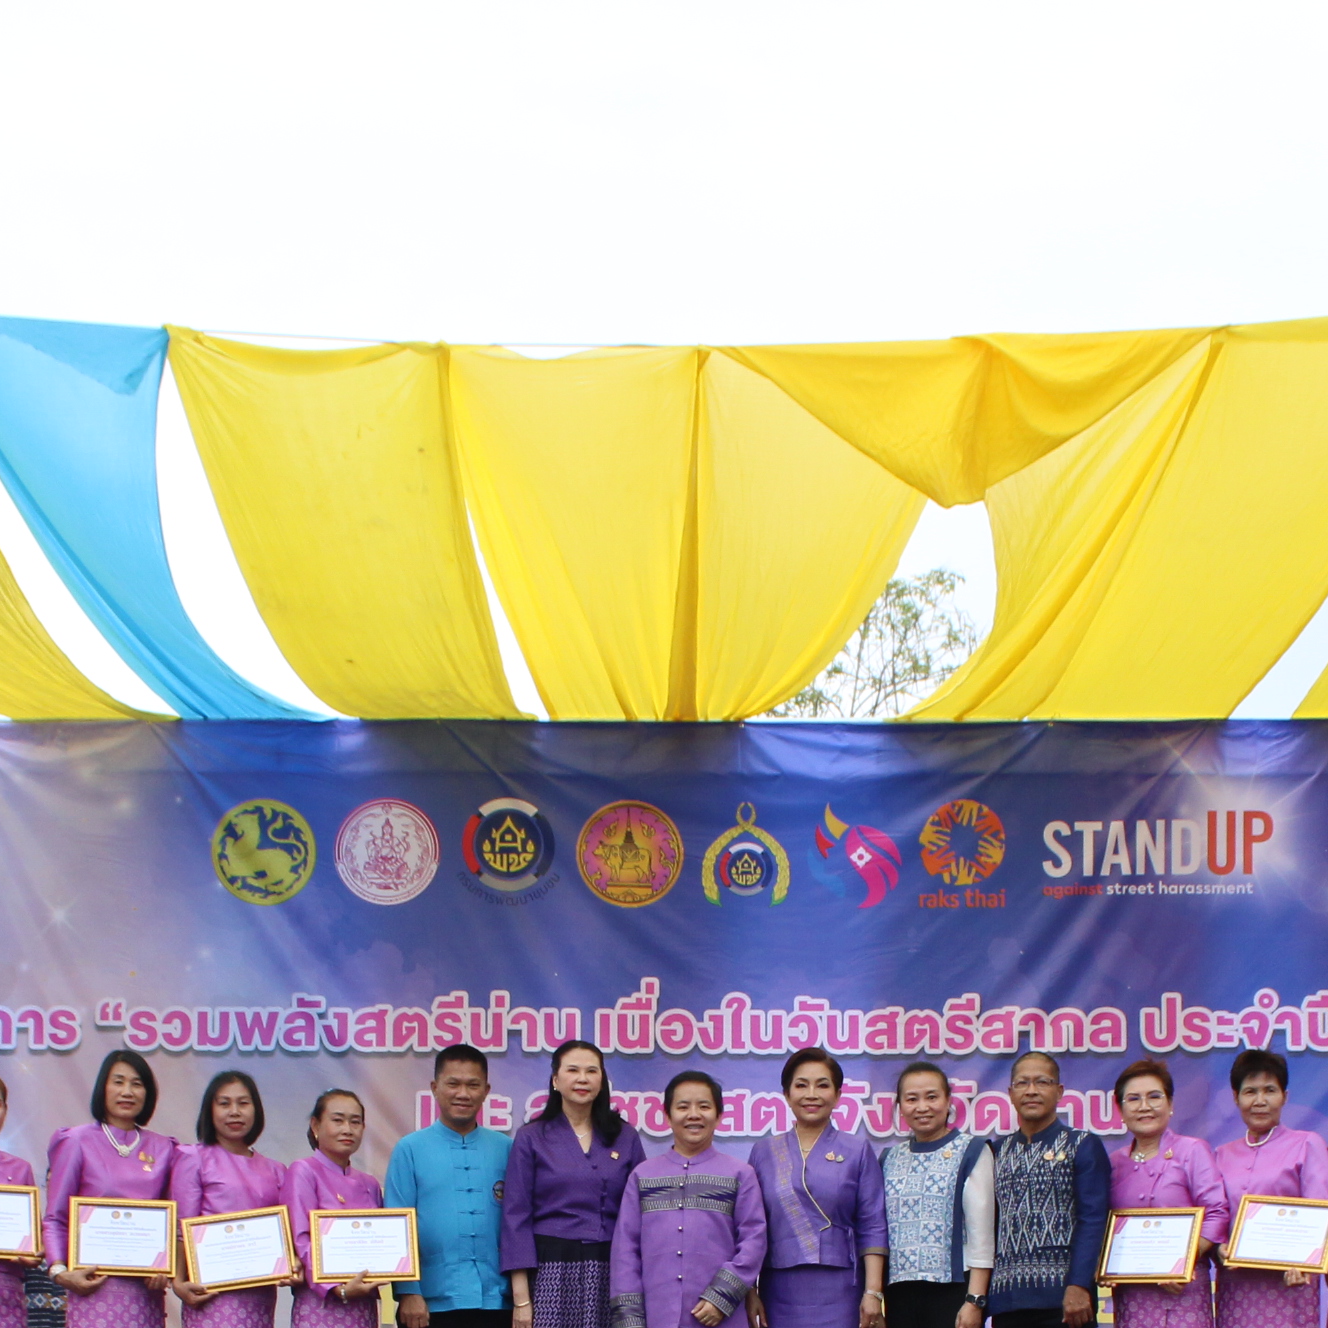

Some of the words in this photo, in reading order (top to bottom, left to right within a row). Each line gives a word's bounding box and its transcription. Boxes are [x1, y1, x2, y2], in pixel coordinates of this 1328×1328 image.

[918, 888, 960, 909] raks
[963, 888, 1007, 909] thai
[1041, 882, 1103, 900] against
[1106, 881, 1155, 896] street
[1158, 880, 1254, 896] harassment
